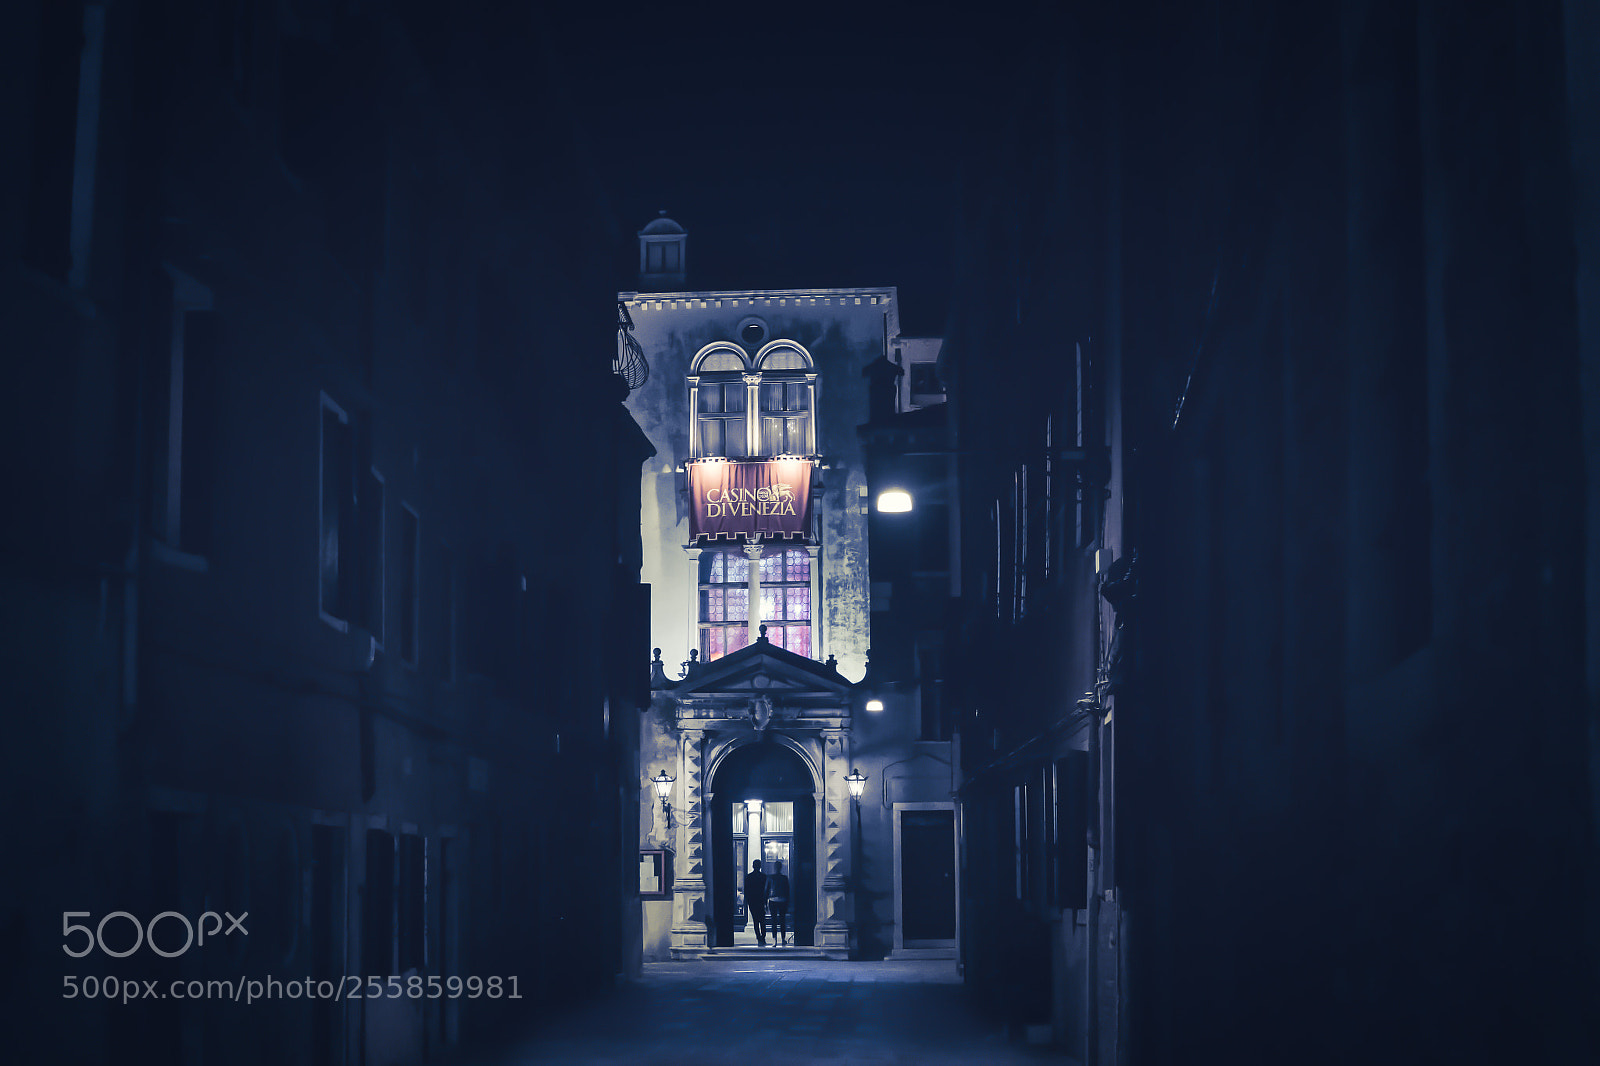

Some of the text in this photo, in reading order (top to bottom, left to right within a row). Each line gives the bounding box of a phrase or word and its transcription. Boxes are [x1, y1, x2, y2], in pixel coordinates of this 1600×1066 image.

[706, 487, 771, 503] CASINO
[706, 501, 796, 517] DI VENEZIA
